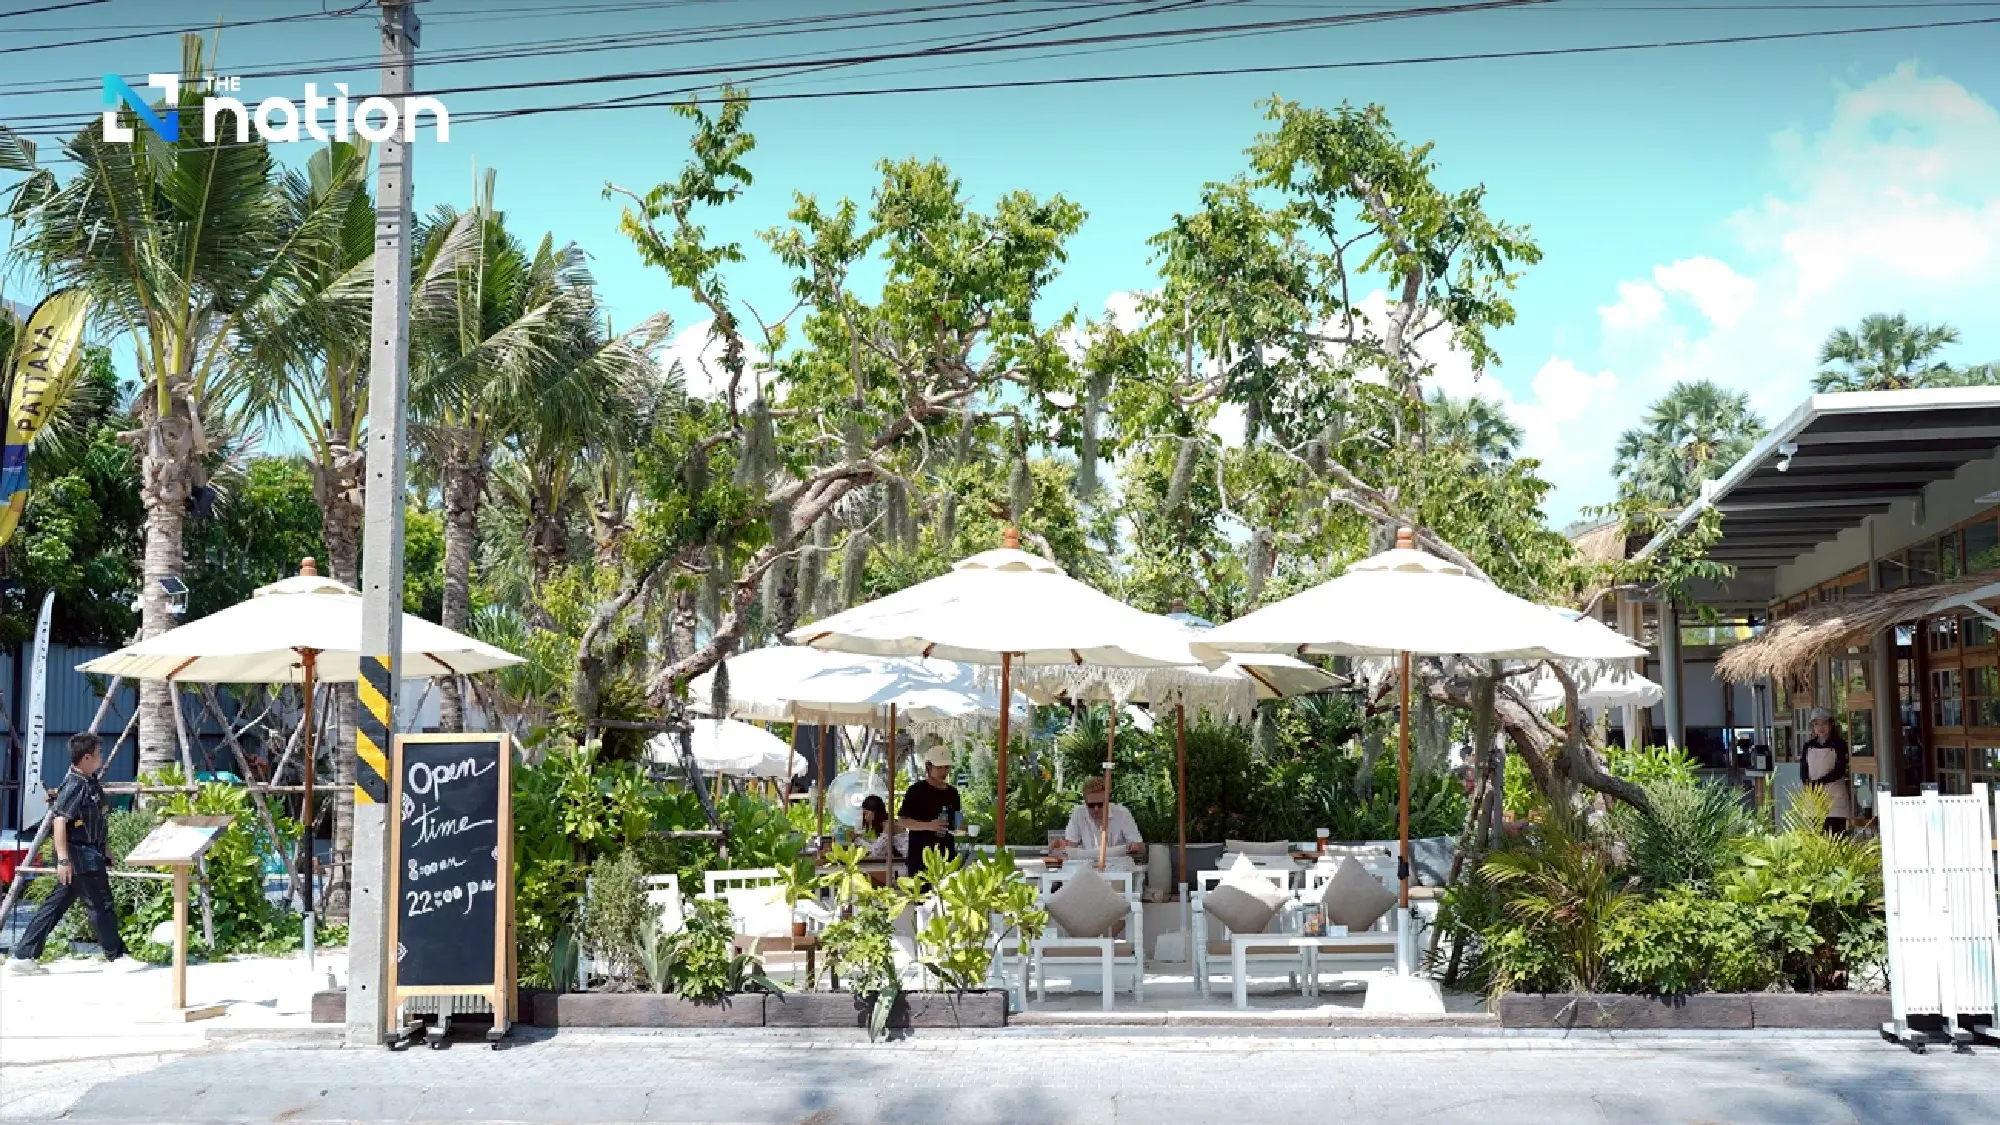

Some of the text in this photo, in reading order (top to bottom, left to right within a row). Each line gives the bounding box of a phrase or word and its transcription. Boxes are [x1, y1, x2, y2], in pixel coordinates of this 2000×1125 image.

[17, 325, 55, 432] PATTAYA
[408, 757, 496, 802] Open
[411, 803, 495, 848] time
